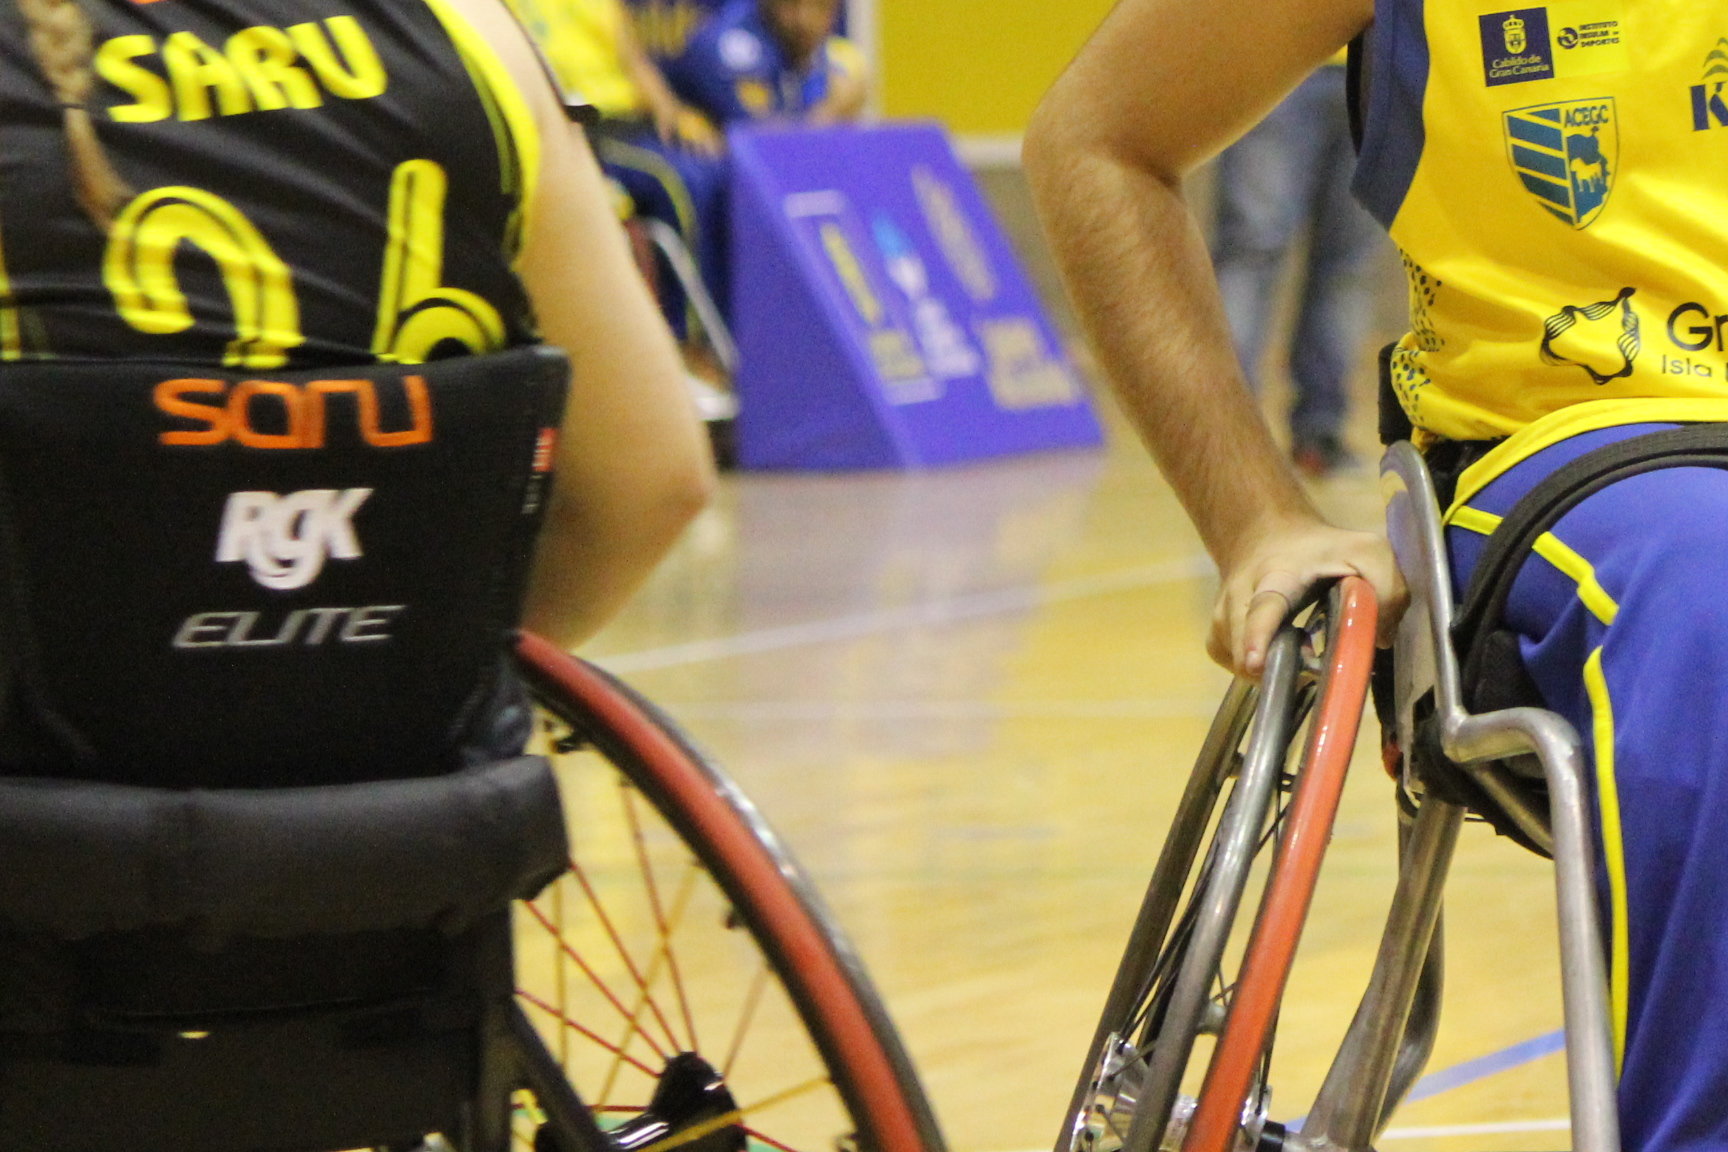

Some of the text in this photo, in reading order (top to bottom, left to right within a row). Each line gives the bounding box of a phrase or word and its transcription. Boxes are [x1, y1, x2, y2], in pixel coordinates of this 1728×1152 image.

[94, 15, 388, 123] SARU
[1489, 63, 1550, 79] Gran Canaria
[1492, 56, 1528, 69] Cabildo
[1564, 104, 1609, 129] ACEGC
[1661, 353, 1713, 378] Isla
[173, 604, 406, 649] ELITE
